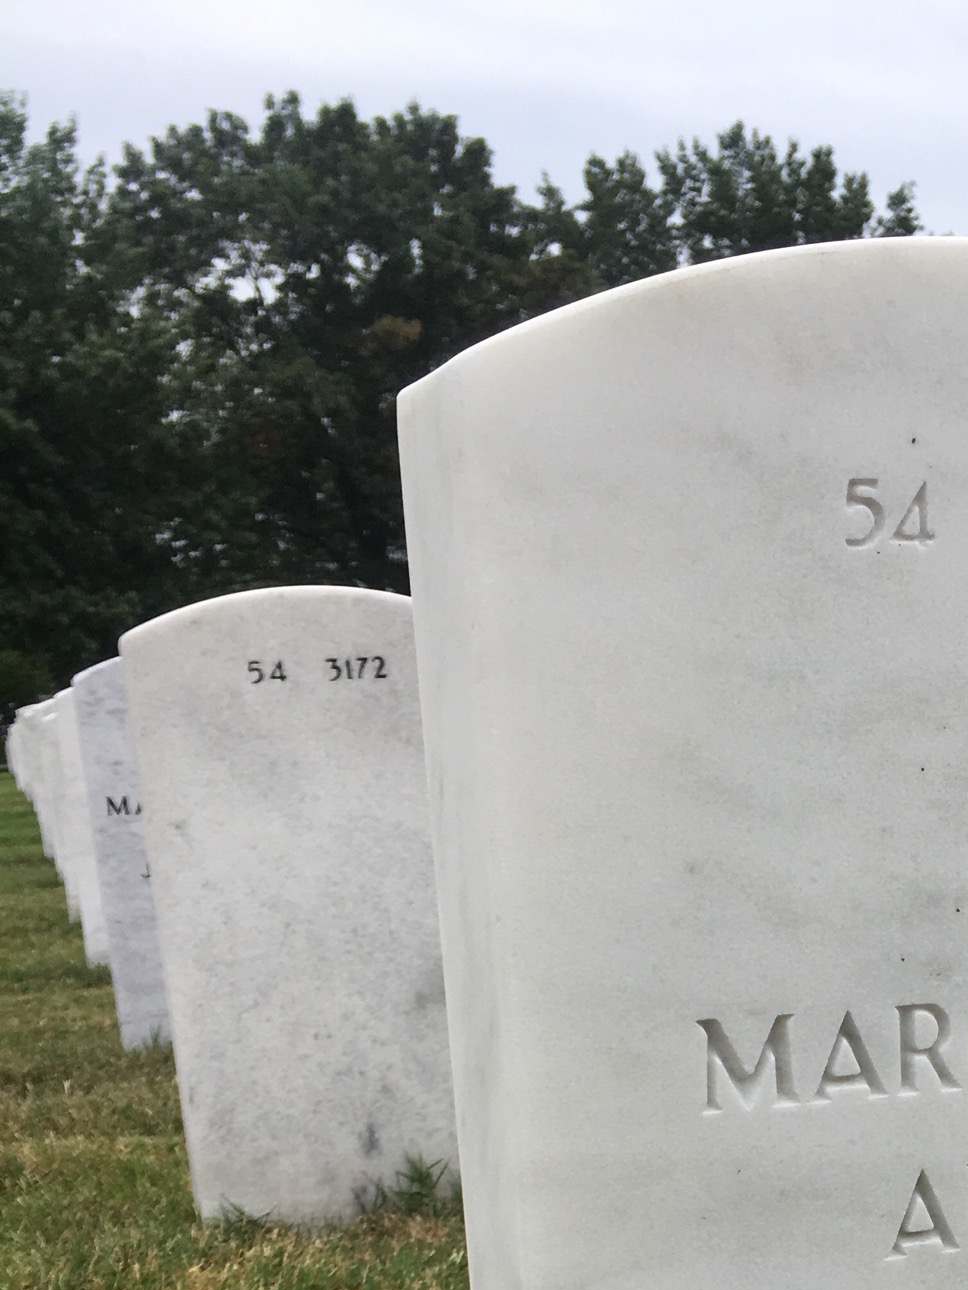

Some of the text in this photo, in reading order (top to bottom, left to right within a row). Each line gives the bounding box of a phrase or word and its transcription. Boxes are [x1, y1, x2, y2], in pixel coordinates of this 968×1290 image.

[845, 478, 936, 549] 54
[247, 656, 388, 684] 54 3172
